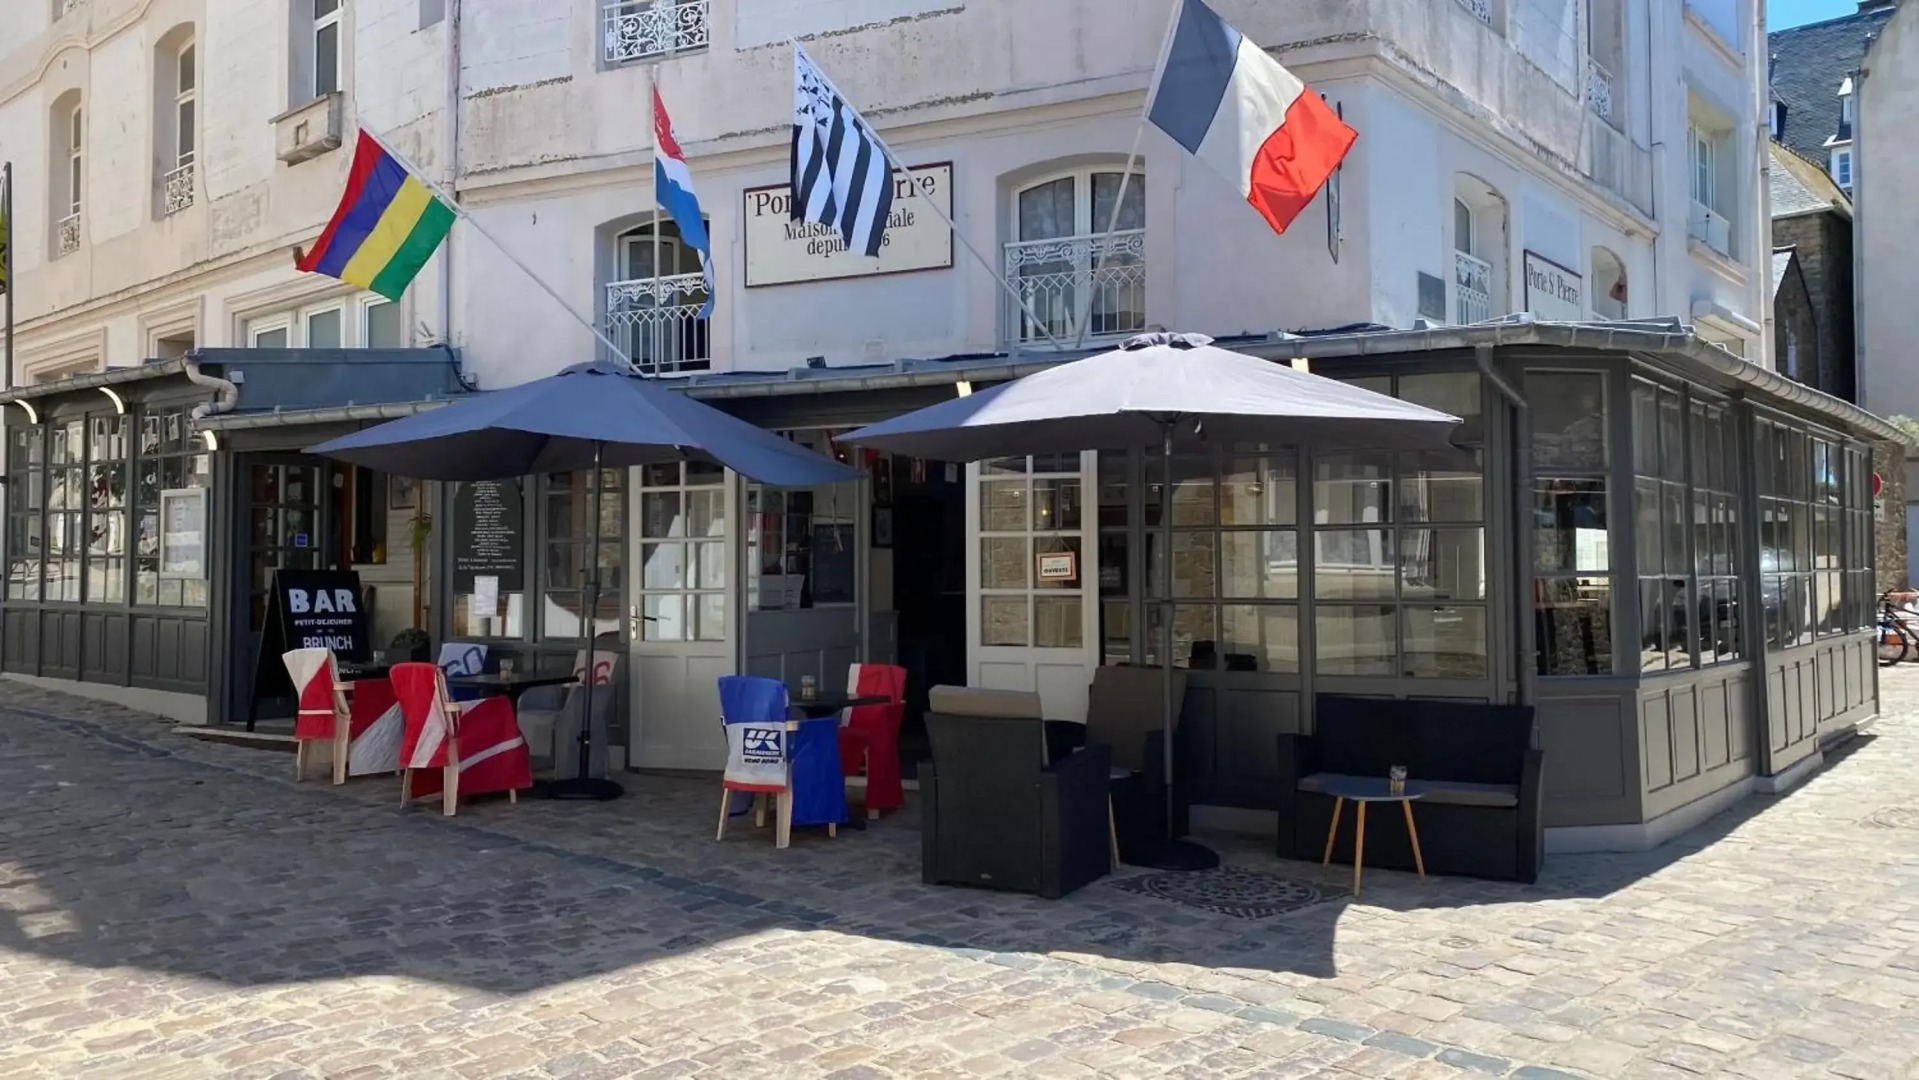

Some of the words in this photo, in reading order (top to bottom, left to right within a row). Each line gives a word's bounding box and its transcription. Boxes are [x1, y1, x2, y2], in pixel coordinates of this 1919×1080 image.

[755, 192, 792, 216] Por
[894, 175, 935, 199] rre
[807, 237, 847, 258] depu
[289, 588, 356, 613] BAR
[303, 635, 353, 650] BRUNCH
